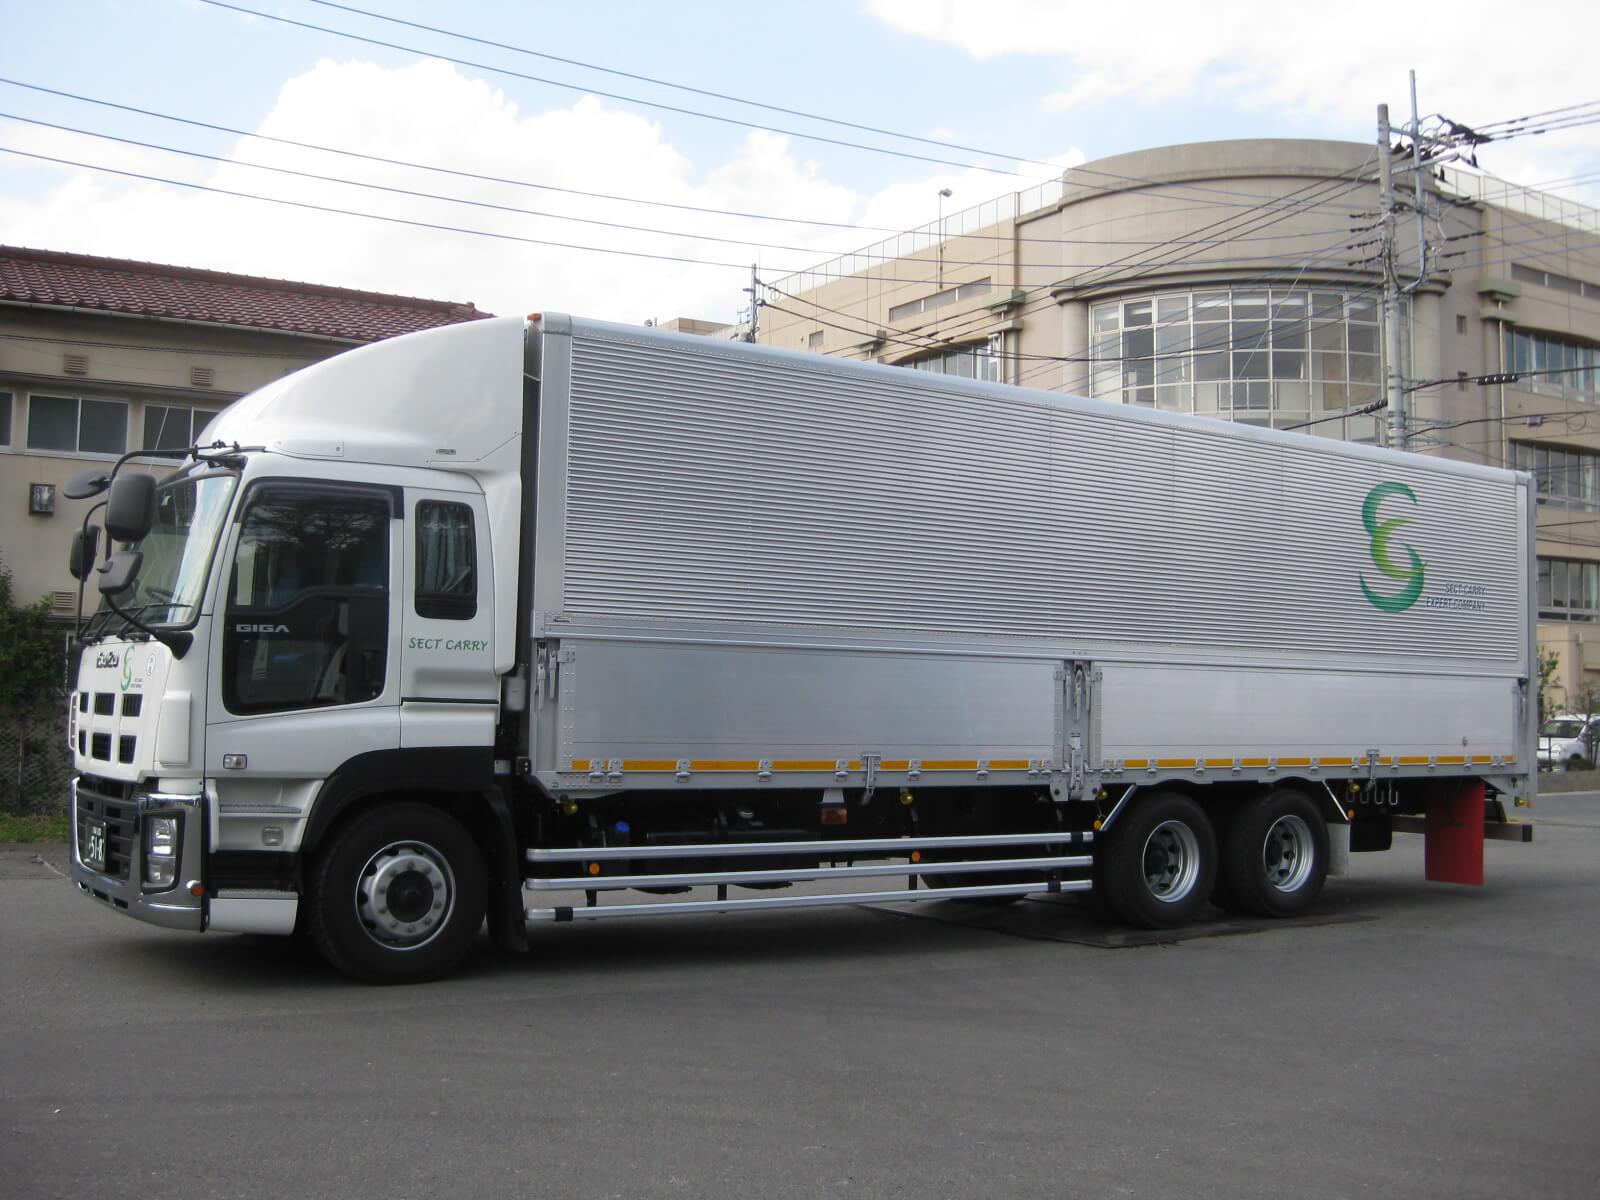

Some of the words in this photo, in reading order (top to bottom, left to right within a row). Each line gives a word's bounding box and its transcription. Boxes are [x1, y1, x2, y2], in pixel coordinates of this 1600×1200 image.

[1444, 583, 1463, 594] SECT
[1463, 584, 1487, 596] CARRY
[1426, 596, 1452, 608] EXPERT
[1453, 598, 1487, 611] COMPANY
[236, 624, 290, 633] GIGA
[408, 637, 443, 649] SECT
[445, 639, 488, 651] CARRY
